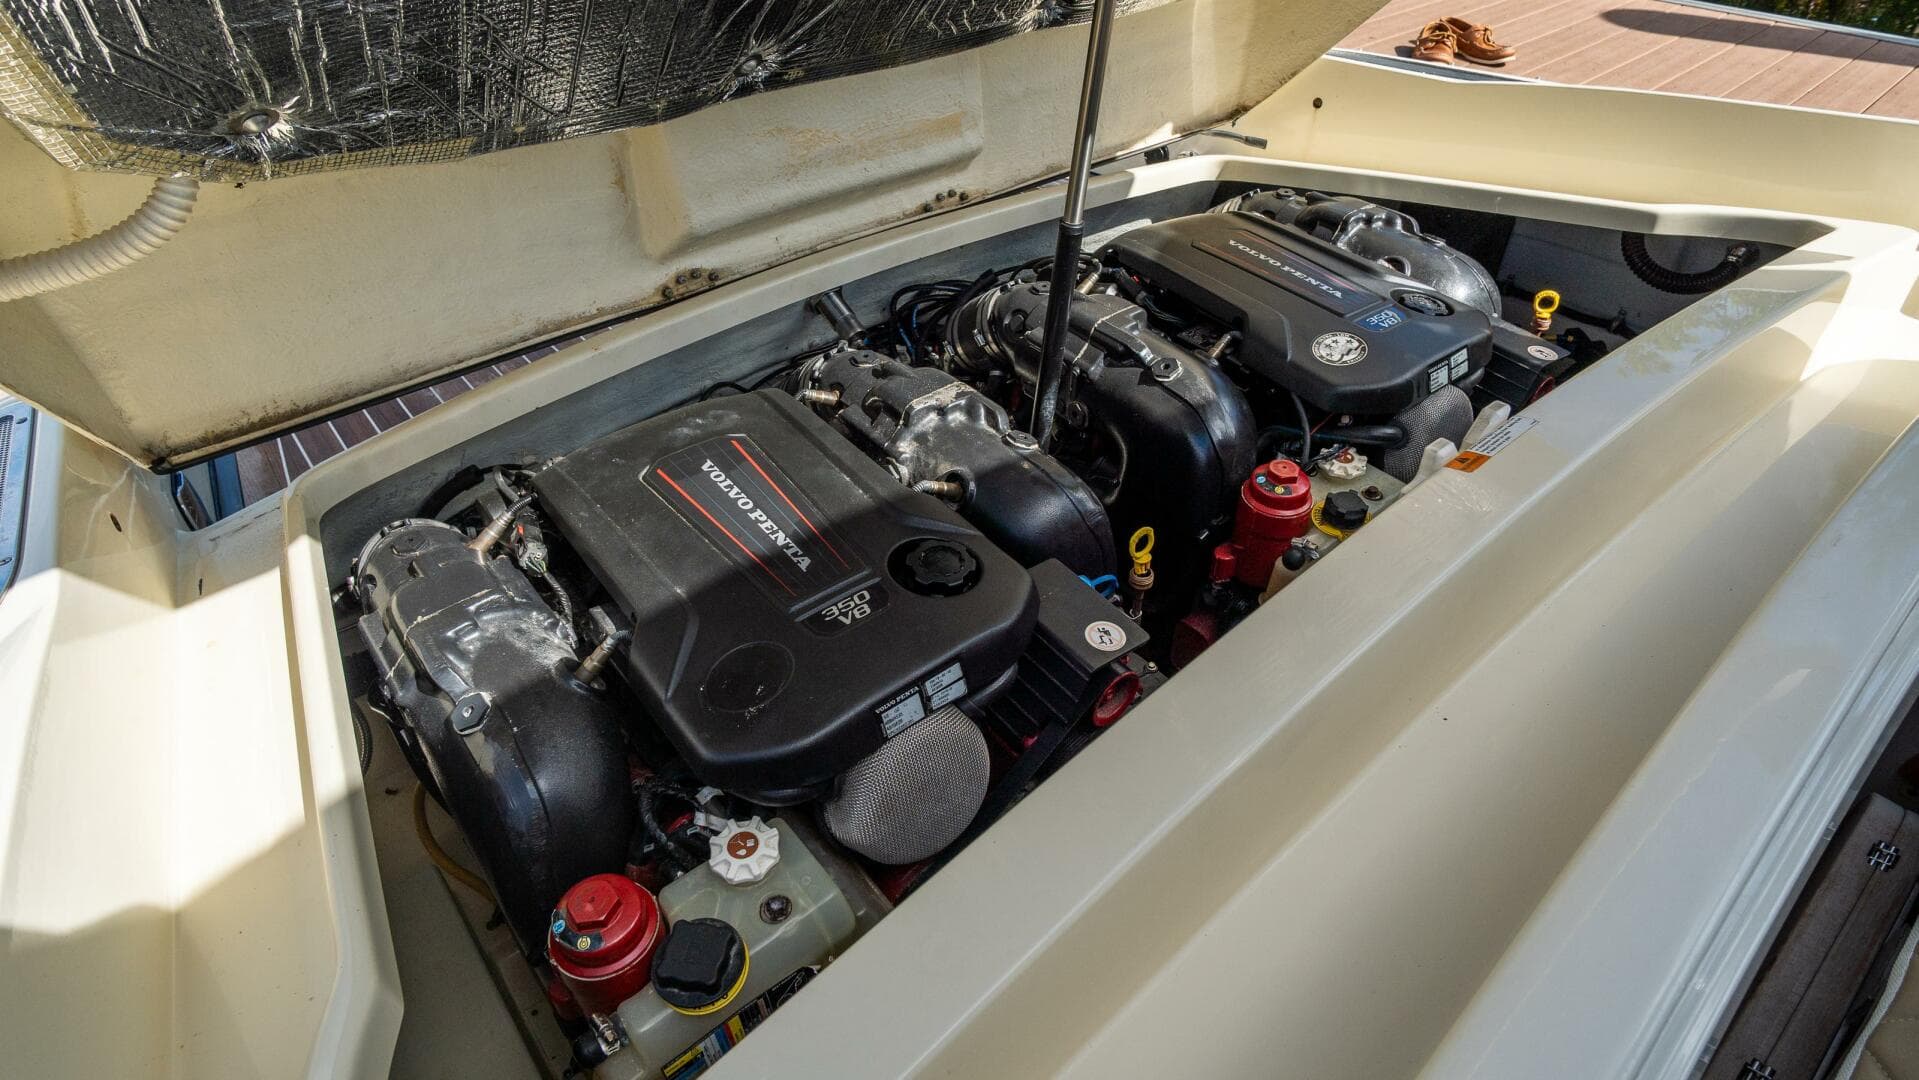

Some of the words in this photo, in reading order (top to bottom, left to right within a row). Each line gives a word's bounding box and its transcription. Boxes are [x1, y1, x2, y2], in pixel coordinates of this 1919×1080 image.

[1229, 240, 1281, 267] VOLVO
[1281, 265, 1342, 298] PENTA
[1366, 310, 1393, 325] 350
[1378, 317, 1398, 328] V8
[701, 459, 753, 510] VOLVO
[747, 508, 811, 572] PENTA
[821, 590, 870, 620] 350
[837, 603, 871, 625] V8
